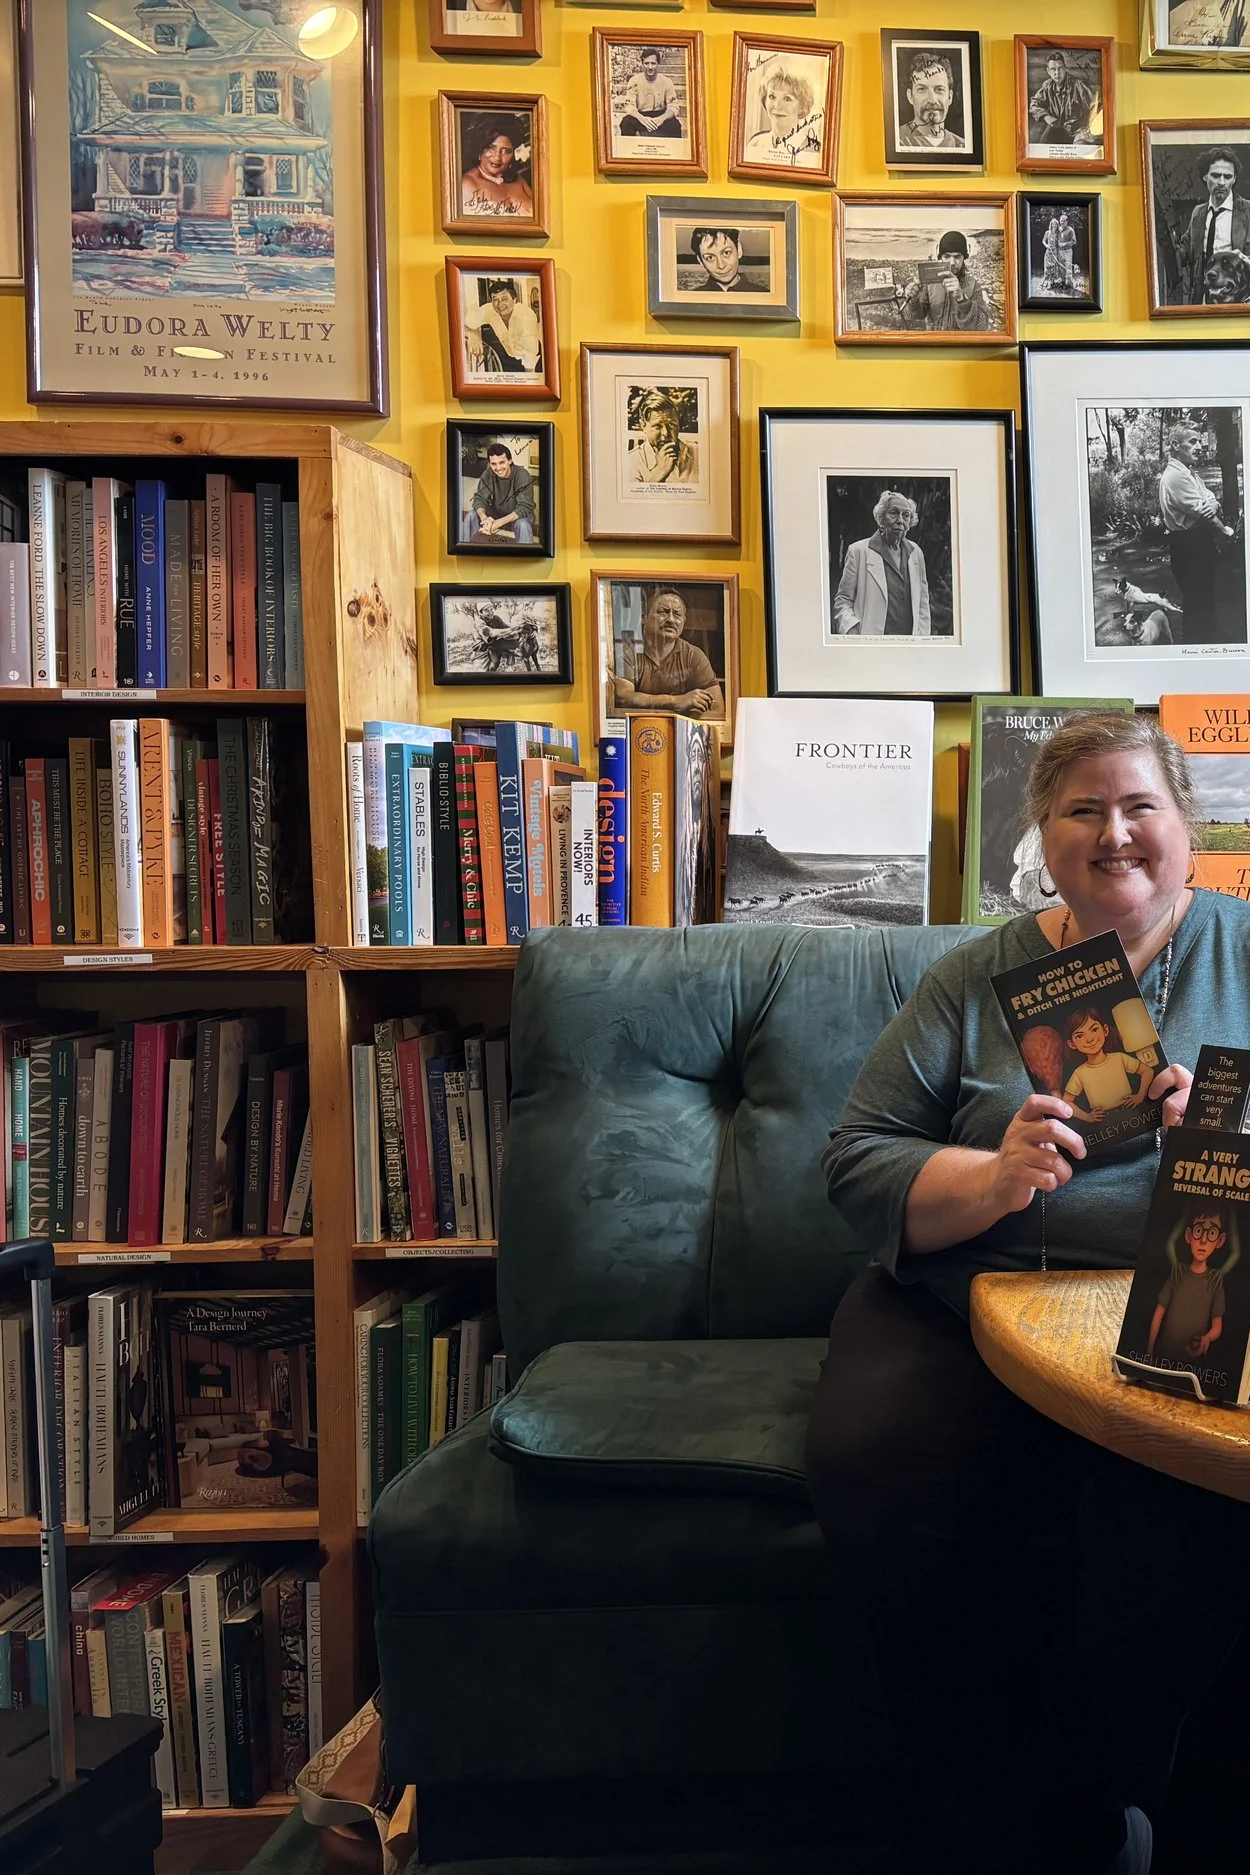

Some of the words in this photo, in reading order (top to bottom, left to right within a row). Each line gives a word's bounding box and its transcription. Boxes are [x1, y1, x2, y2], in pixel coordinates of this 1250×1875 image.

[74, 309, 210, 337] EUDORA
[220, 313, 336, 342] WELTY
[75, 343, 120, 356] FILM
[131, 345, 145, 356] &
[247, 348, 336, 363] FESTIVAL
[144, 365, 181, 378] MAY
[233, 371, 269, 381] 1996
[33, 484, 43, 528] LEANNE
[34, 531, 43, 562] FORD
[140, 514, 156, 565] MOOD
[35, 567, 44, 584] THE
[36, 586, 45, 622] SLOW
[36, 624, 46, 661] DOWN
[115, 690, 137, 698] DESIGN
[1005, 716, 1051, 730] BRUCE
[795, 742, 912, 760] FRONTIER
[640, 768, 649, 787] The
[826, 762, 857, 771] Cowboys
[859, 762, 867, 770] of
[868, 762, 878, 770] the
[117, 750, 128, 834] SUNNYLANDS
[499, 774, 519, 816] KIT
[640, 789, 650, 815] North
[391, 773, 402, 870] EXTRAORDINARY
[414, 781, 425, 838] STABLES
[651, 792, 662, 829] Edward
[599, 777, 626, 884] design
[640, 817, 650, 862] American
[652, 832, 662, 840] S.
[31, 799, 45, 902] APHROCHIC
[462, 829, 474, 865] Merry
[503, 826, 524, 895] KEMP
[573, 841, 583, 873] NOW!
[583, 829, 594, 886] INTERIORS
[652, 843, 662, 872] Curtis
[465, 869, 475, 881] &
[640, 864, 650, 896] Indian
[394, 874, 403, 913] POOLS
[466, 882, 477, 909] Chic
[109, 955, 133, 963] STYLES
[1037, 966, 1067, 985] HOW
[1067, 959, 1083, 973] TO
[1010, 987, 1044, 1011] FRY
[1045, 957, 1121, 998] CHICKEN
[1017, 1011, 1025, 1020] &
[1027, 1001, 1053, 1017] DITCH
[1054, 993, 1071, 1007] THE
[1072, 973, 1124, 1000] NIGHTLIGHT
[1208, 1068, 1238, 1081] biggest
[1219, 1056, 1233, 1067] The
[1197, 1080, 1242, 1093] adventures
[1200, 1094, 1213, 1103] can
[1215, 1094, 1233, 1105] start
[1200, 1117, 1223, 1129] small.
[1205, 1106, 1223, 1117] very
[77, 1115, 90, 1148] down
[77, 1151, 88, 1163] to
[1200, 1150, 1210, 1162] A
[1212, 1151, 1240, 1165] VERY
[75, 1165, 88, 1196] earth
[1173, 1183, 1211, 1198] REVERSAL
[1212, 1186, 1223, 1198] OF
[186, 1308, 195, 1318] A
[197, 1307, 229, 1320] Design
[230, 1307, 267, 1320] Journey
[187, 1322, 208, 1331] Tara
[209, 1320, 247, 1331] Bernerd
[75, 1624, 84, 1655] china
